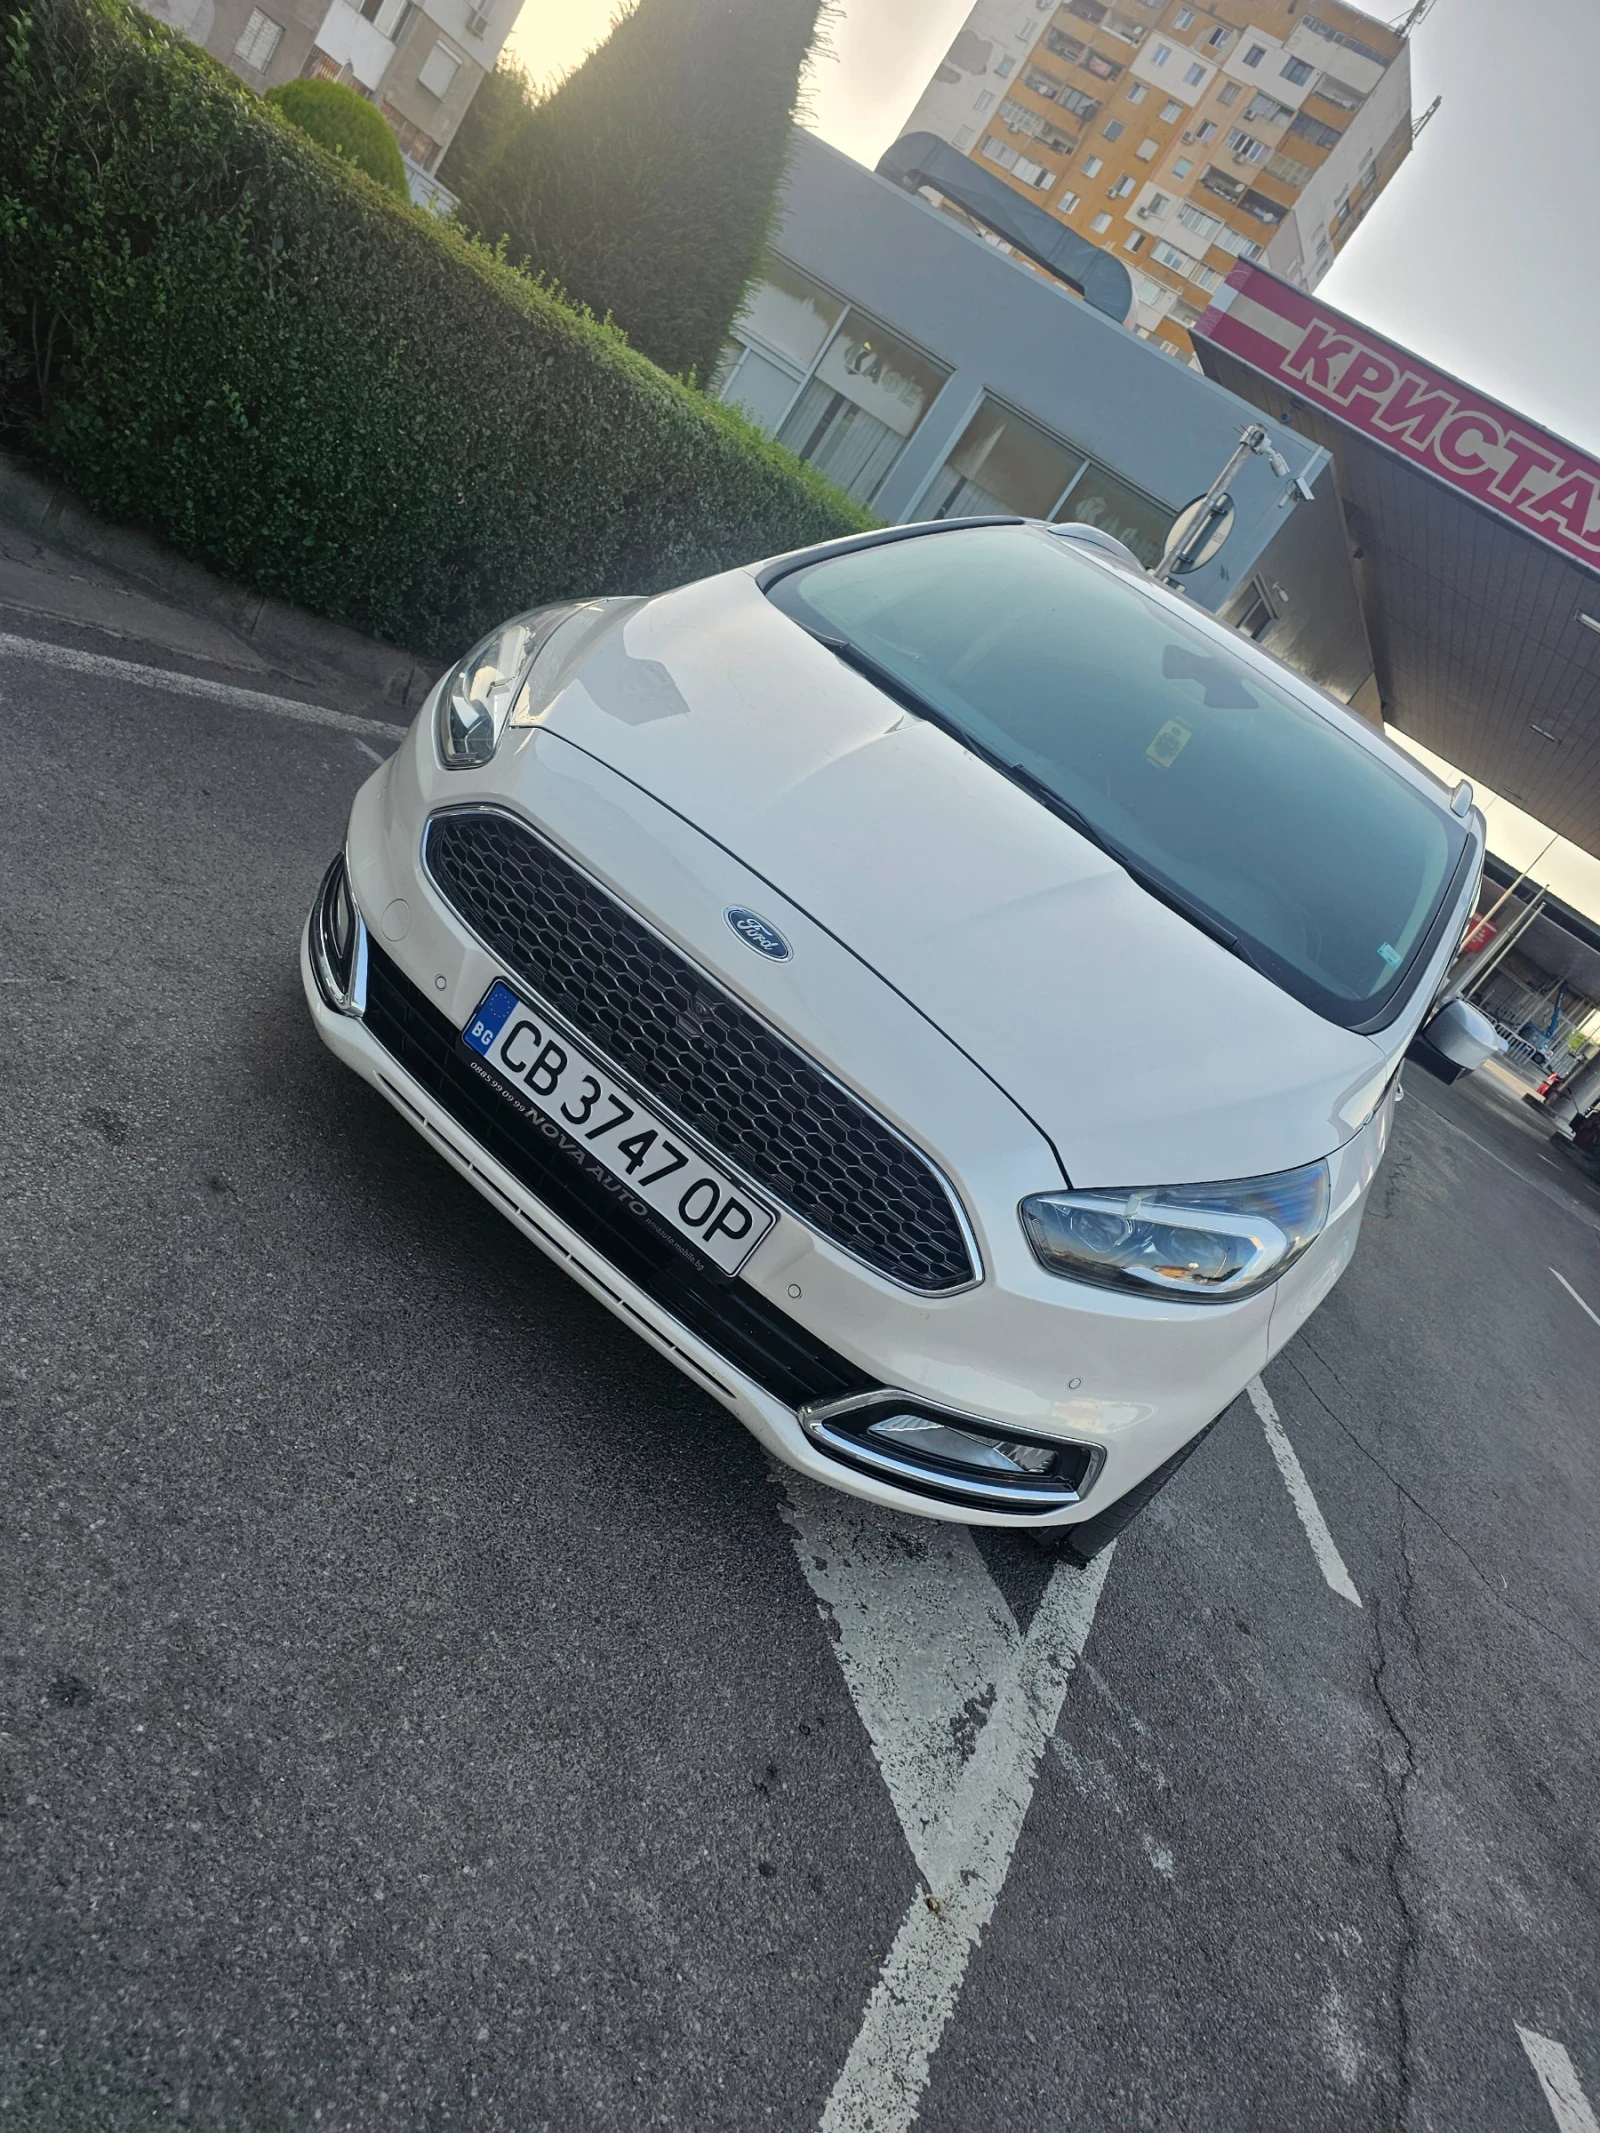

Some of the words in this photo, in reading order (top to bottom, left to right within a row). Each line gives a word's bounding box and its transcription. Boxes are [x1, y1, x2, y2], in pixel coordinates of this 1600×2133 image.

[1281, 318, 1600, 552] КРИСТА
[737, 918, 779, 950] Ford
[471, 1022, 493, 1045] BG
[470, 1062, 492, 1083] 0885
[490, 1080, 503, 1092] 99
[502, 1090, 514, 1102] 09
[514, 1101, 526, 1112] 99
[524, 1107, 586, 1164] NOVA
[585, 1166, 648, 1216] AUTO
[500, 1020, 568, 1096] CB
[560, 1075, 689, 1186] 3747
[678, 1178, 752, 1242] OP
